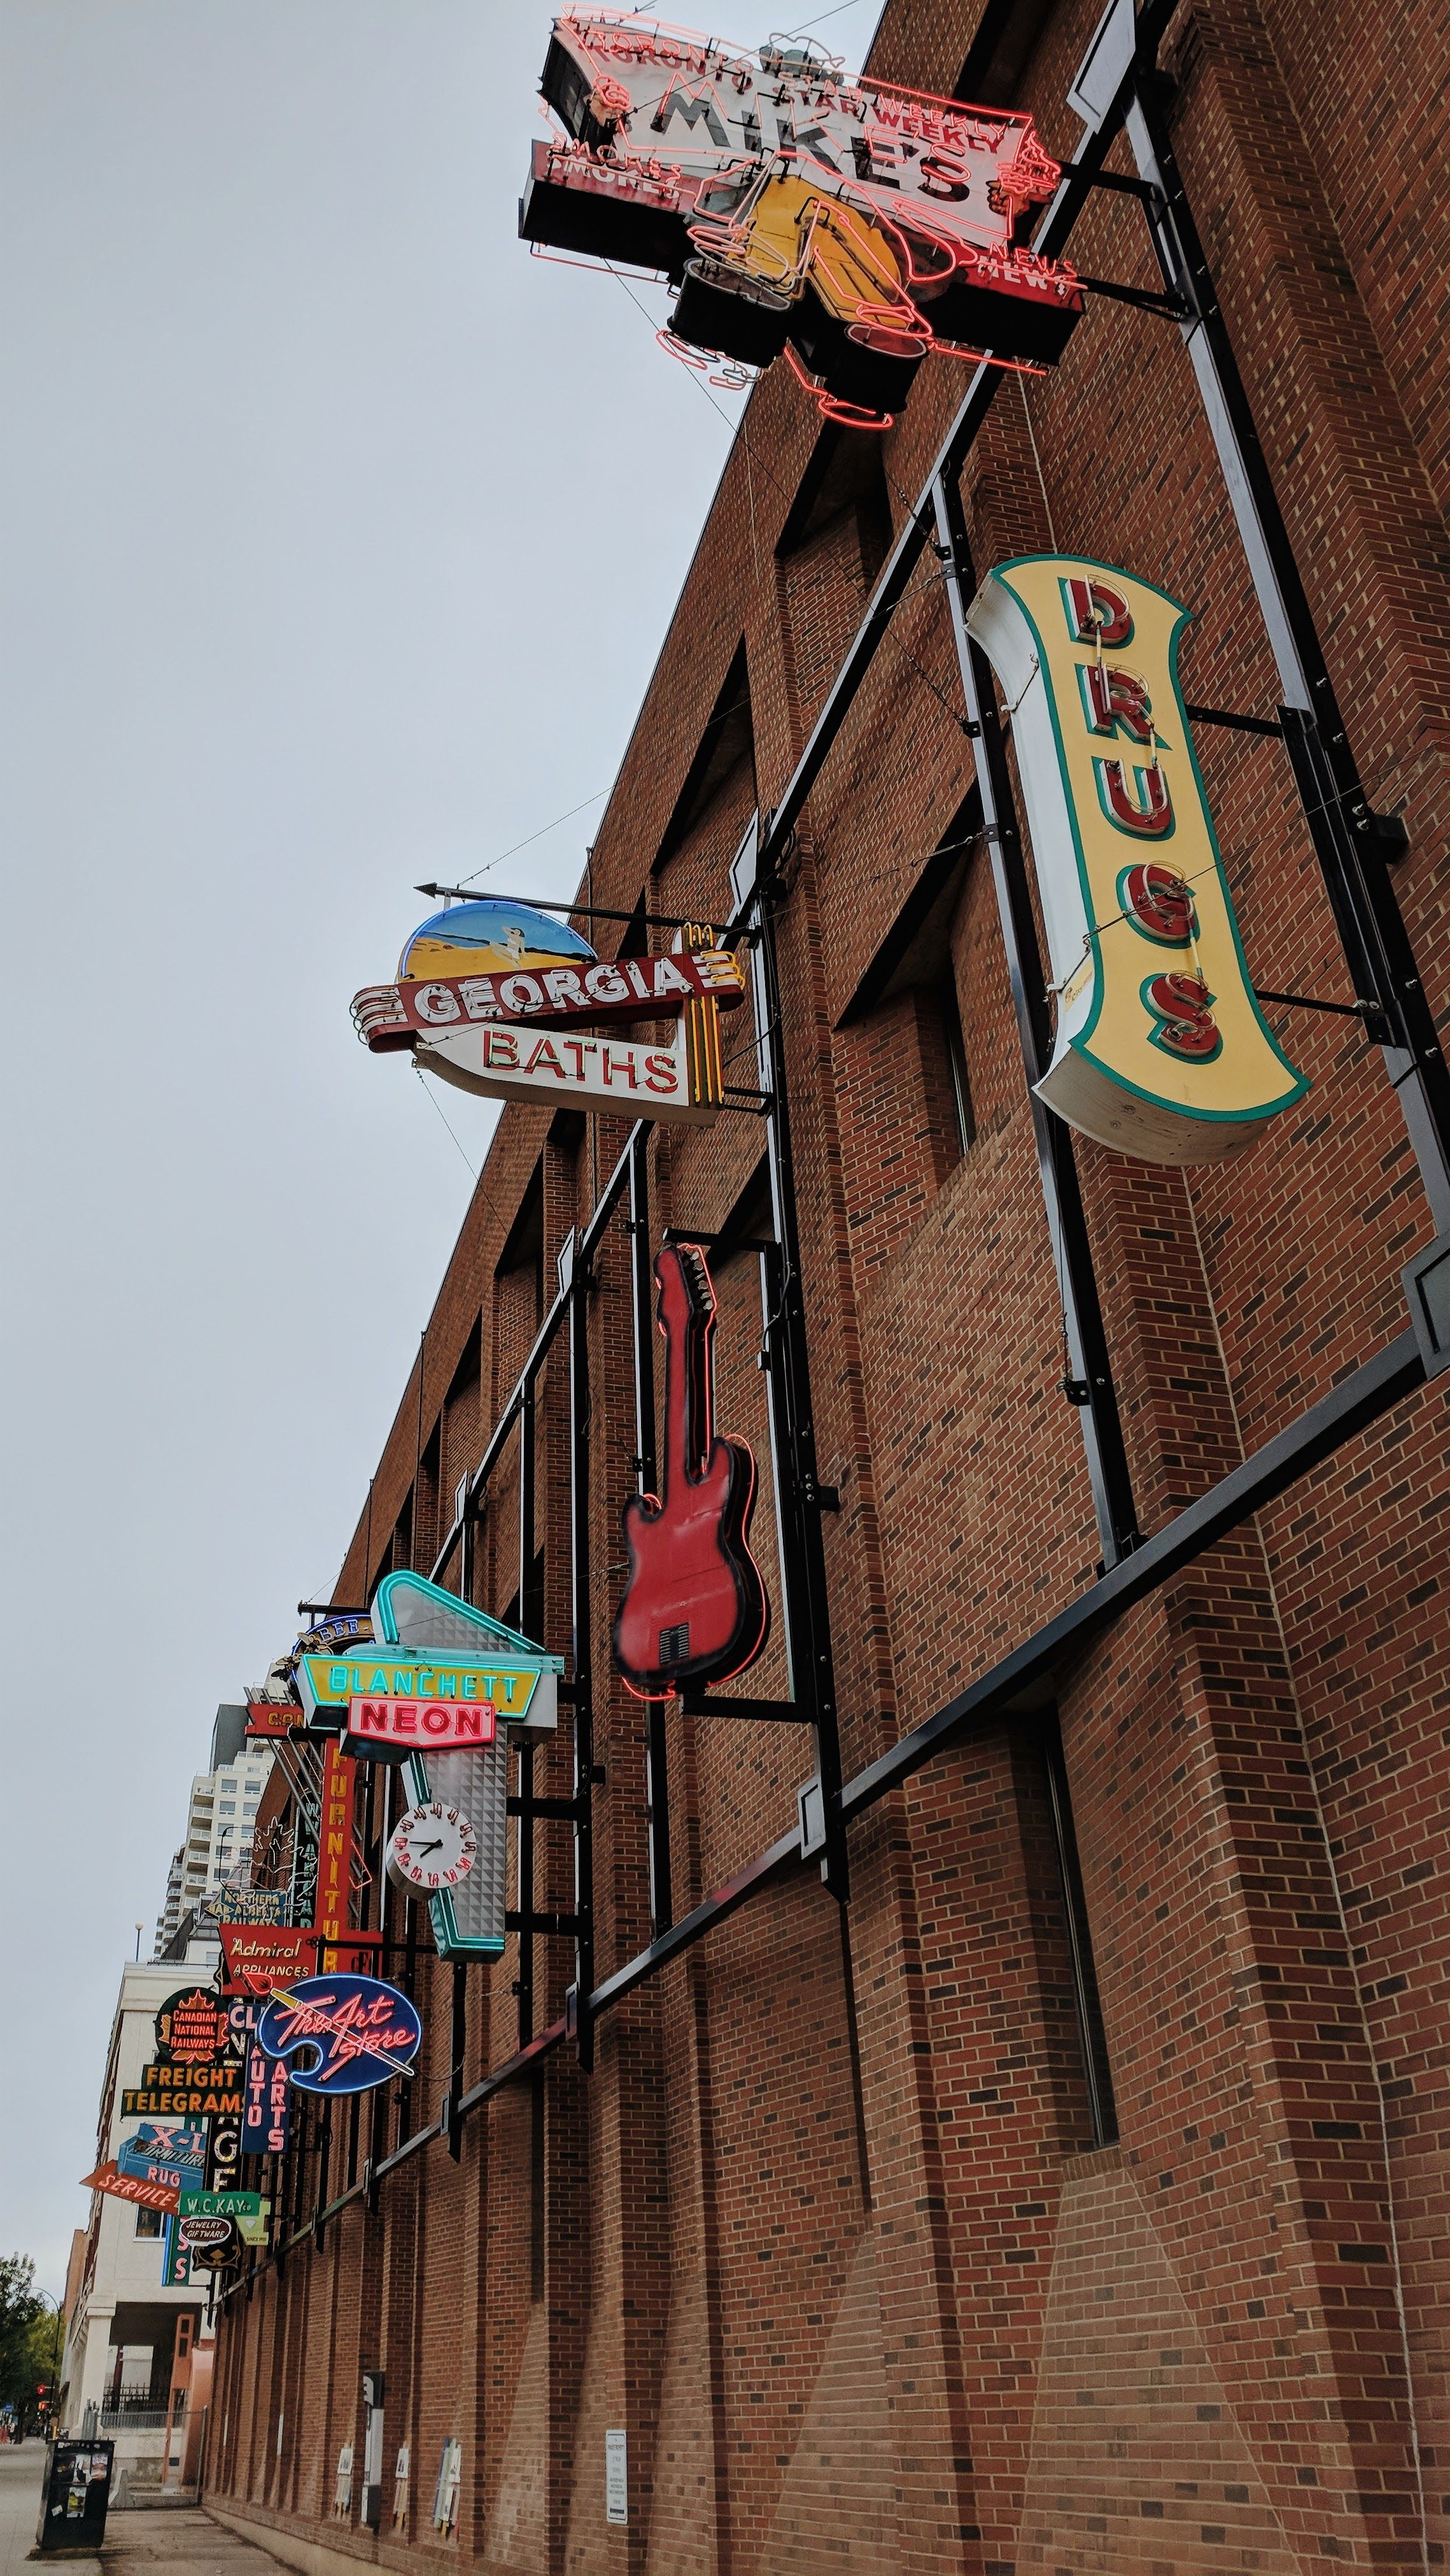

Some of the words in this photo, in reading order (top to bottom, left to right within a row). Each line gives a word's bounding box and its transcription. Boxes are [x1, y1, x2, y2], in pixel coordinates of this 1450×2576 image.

[579, 31, 754, 92] TORONTO
[771, 71, 864, 120] STAR
[873, 92, 1007, 154] WEEKLY
[650, 72, 971, 202] MIKE'S
[546, 132, 682, 199] SMOKES
[977, 242, 1078, 296] NEWS
[1059, 574, 1222, 1064] DRUGS
[414, 957, 693, 1023] GEORGIA
[483, 1028, 679, 1093] BATHS
[330, 1666, 517, 1698] BLANCHETT
[360, 1703, 482, 1736] NEON
[224, 1891, 280, 1905] NORTHERN
[230, 1938, 301, 1957] Admiral
[233, 1964, 309, 1976] APPLIANCES
[173, 2010, 216, 2022] CANADIAN
[174, 2024, 215, 2036] NATIONAL
[273, 1995, 336, 2047] The
[328, 1993, 395, 2059] Art
[171, 2037, 215, 2049] RAILWAYS
[146, 2068, 237, 2087] FREIGHT
[247, 2045, 265, 2127] AUTO
[125, 2091, 244, 2113] TELEGRAM
[268, 2061, 288, 2152] ARTS
[149, 2126, 206, 2154] X-L
[98, 2174, 176, 2206] SERVICE
[148, 2166, 180, 2187] RUG
